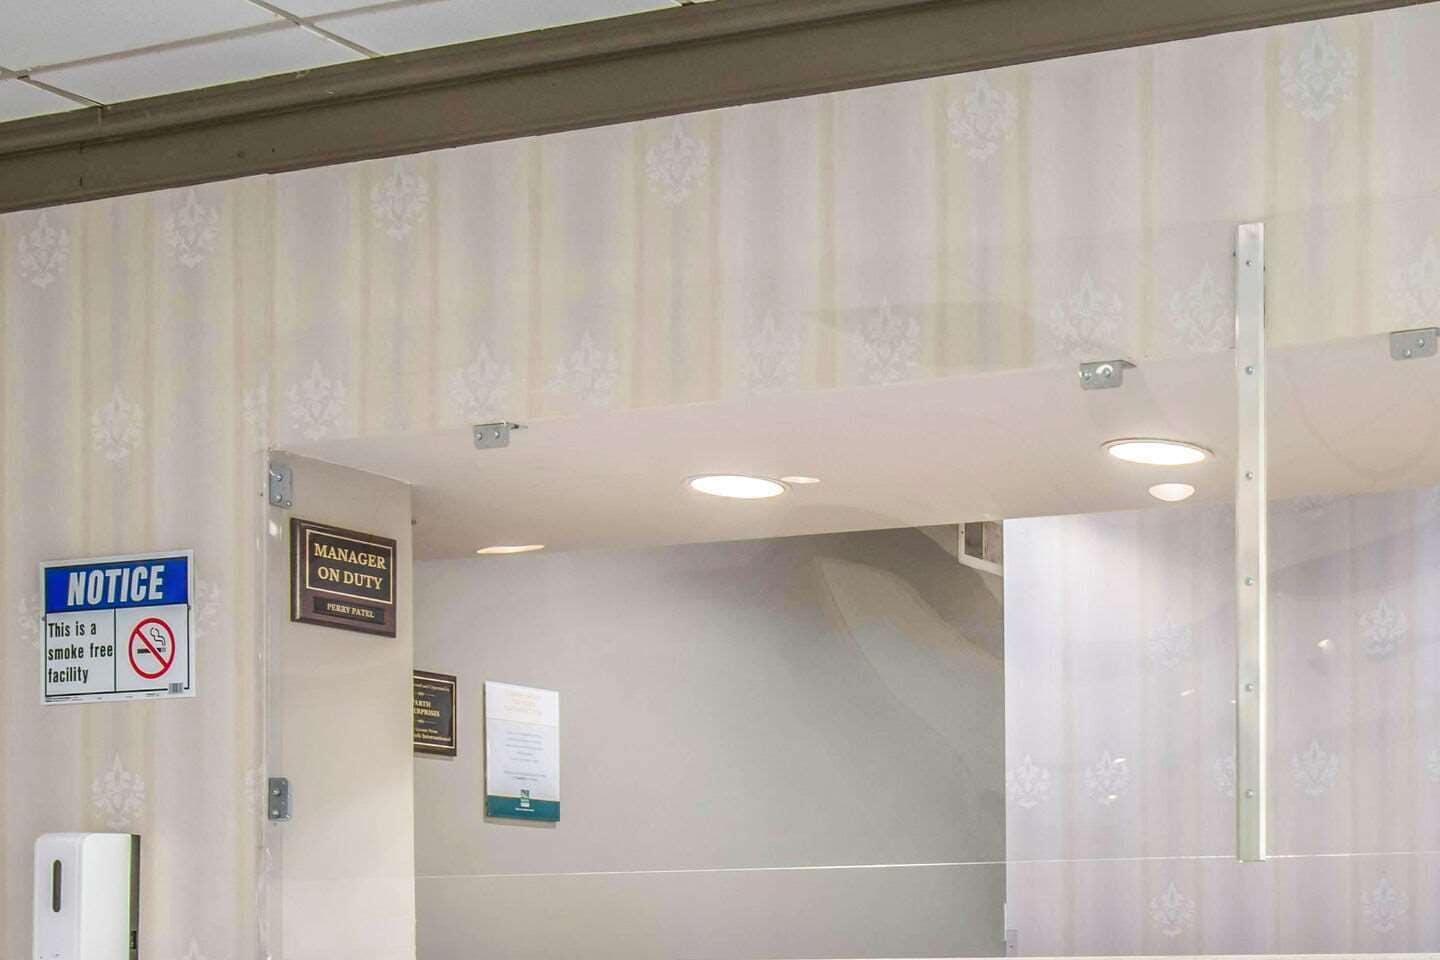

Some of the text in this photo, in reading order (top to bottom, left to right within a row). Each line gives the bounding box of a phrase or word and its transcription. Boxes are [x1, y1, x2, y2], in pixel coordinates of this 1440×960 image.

[313, 542, 387, 570] MANAGER
[66, 565, 165, 606] NOTICE
[317, 566, 383, 590] ON DUTY
[327, 602, 375, 619] PERRY PATEL
[48, 621, 97, 638] This is a
[48, 643, 113, 661] smoke free
[48, 666, 89, 684] facility
